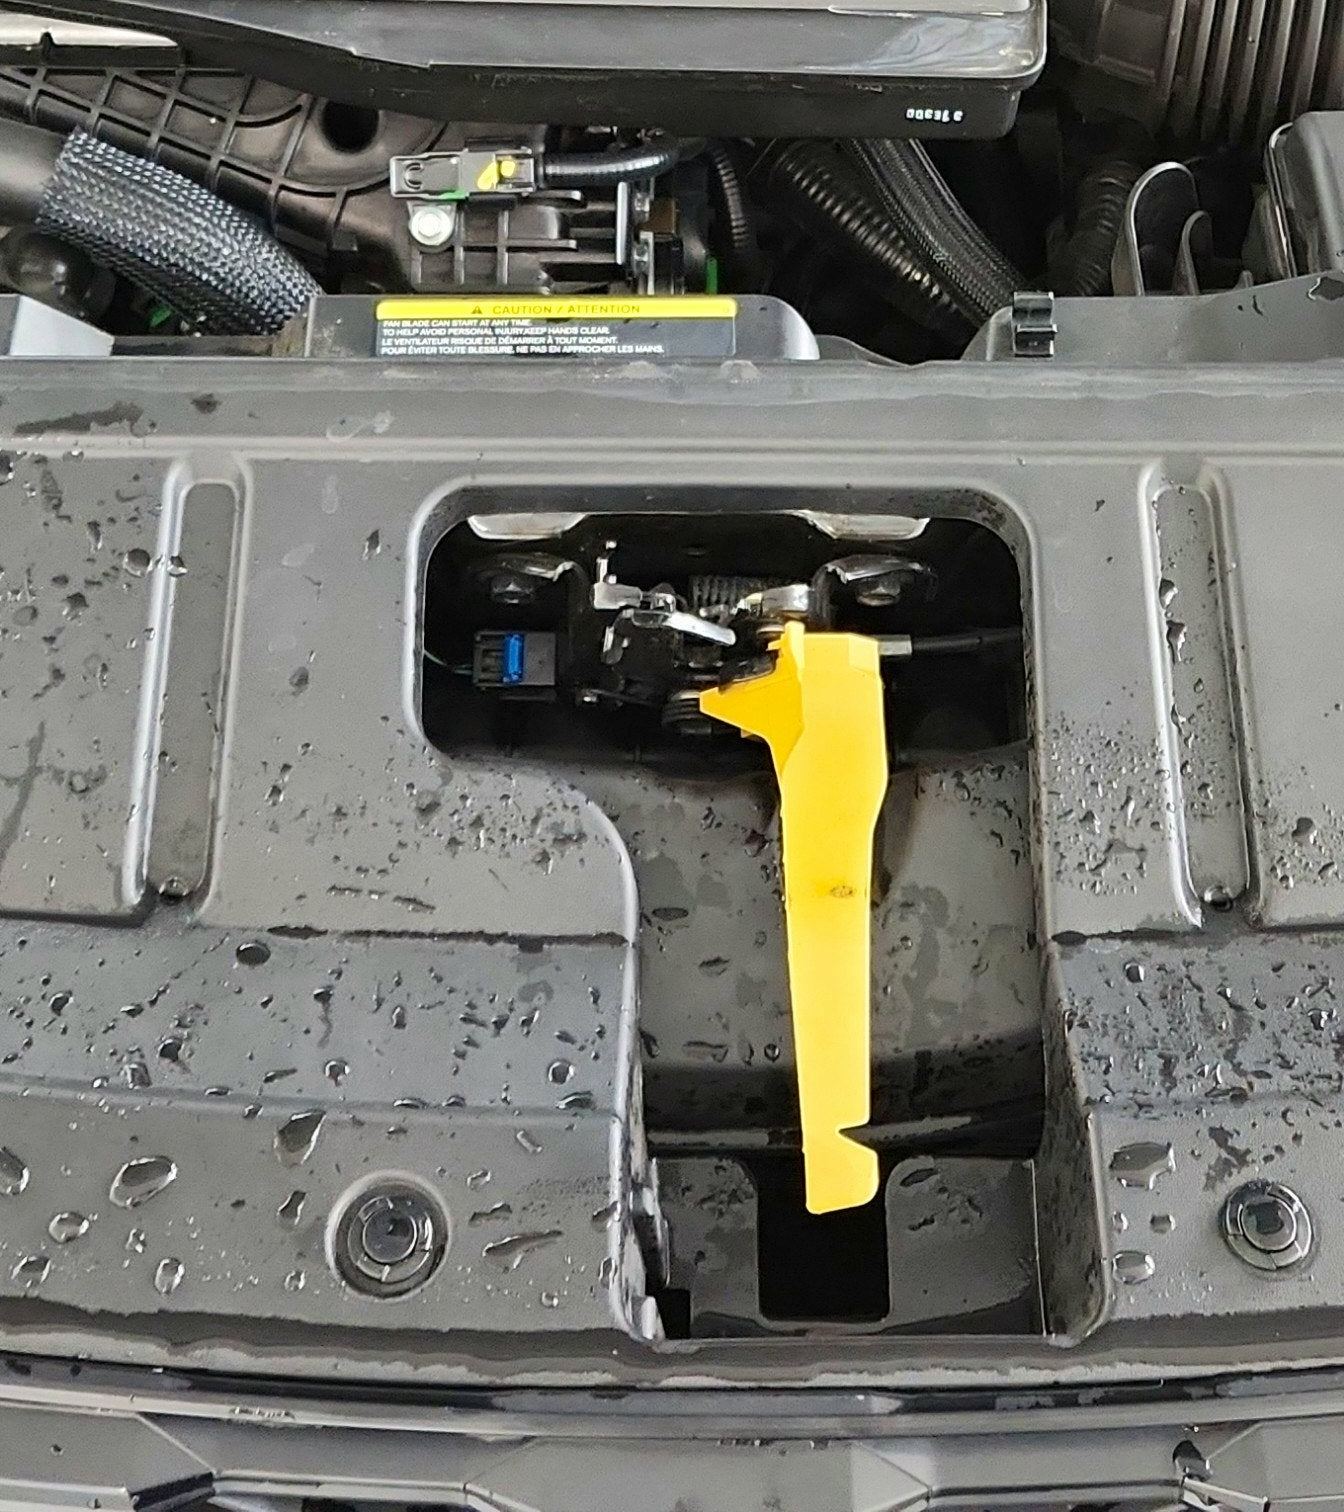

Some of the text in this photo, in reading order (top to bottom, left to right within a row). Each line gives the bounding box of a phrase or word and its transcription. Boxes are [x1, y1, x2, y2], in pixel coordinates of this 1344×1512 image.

[492, 305, 553, 315] CAUTION
[567, 305, 640, 315] ATTENTION
[382, 327, 395, 336] TO
[396, 327, 419, 336] HELP
[419, 327, 447, 336] AVOID
[448, 327, 493, 336] PERSONAL
[548, 327, 578, 335] HANDS
[382, 337, 393, 345] LE
[394, 337, 449, 345] VENTILATEUR
[450, 337, 484, 345] RISQUE
[484, 337, 496, 345] DE
[555, 336, 578, 345] TOUT
[381, 346, 407, 354] POUR
[438, 346, 466, 354] TOUTE
[516, 346, 529, 354] NE
[529, 346, 548, 354] PAS
[548, 346, 561, 354] EN
[561, 346, 616, 354] APPROCHER
[617, 345, 634, 353] LES
